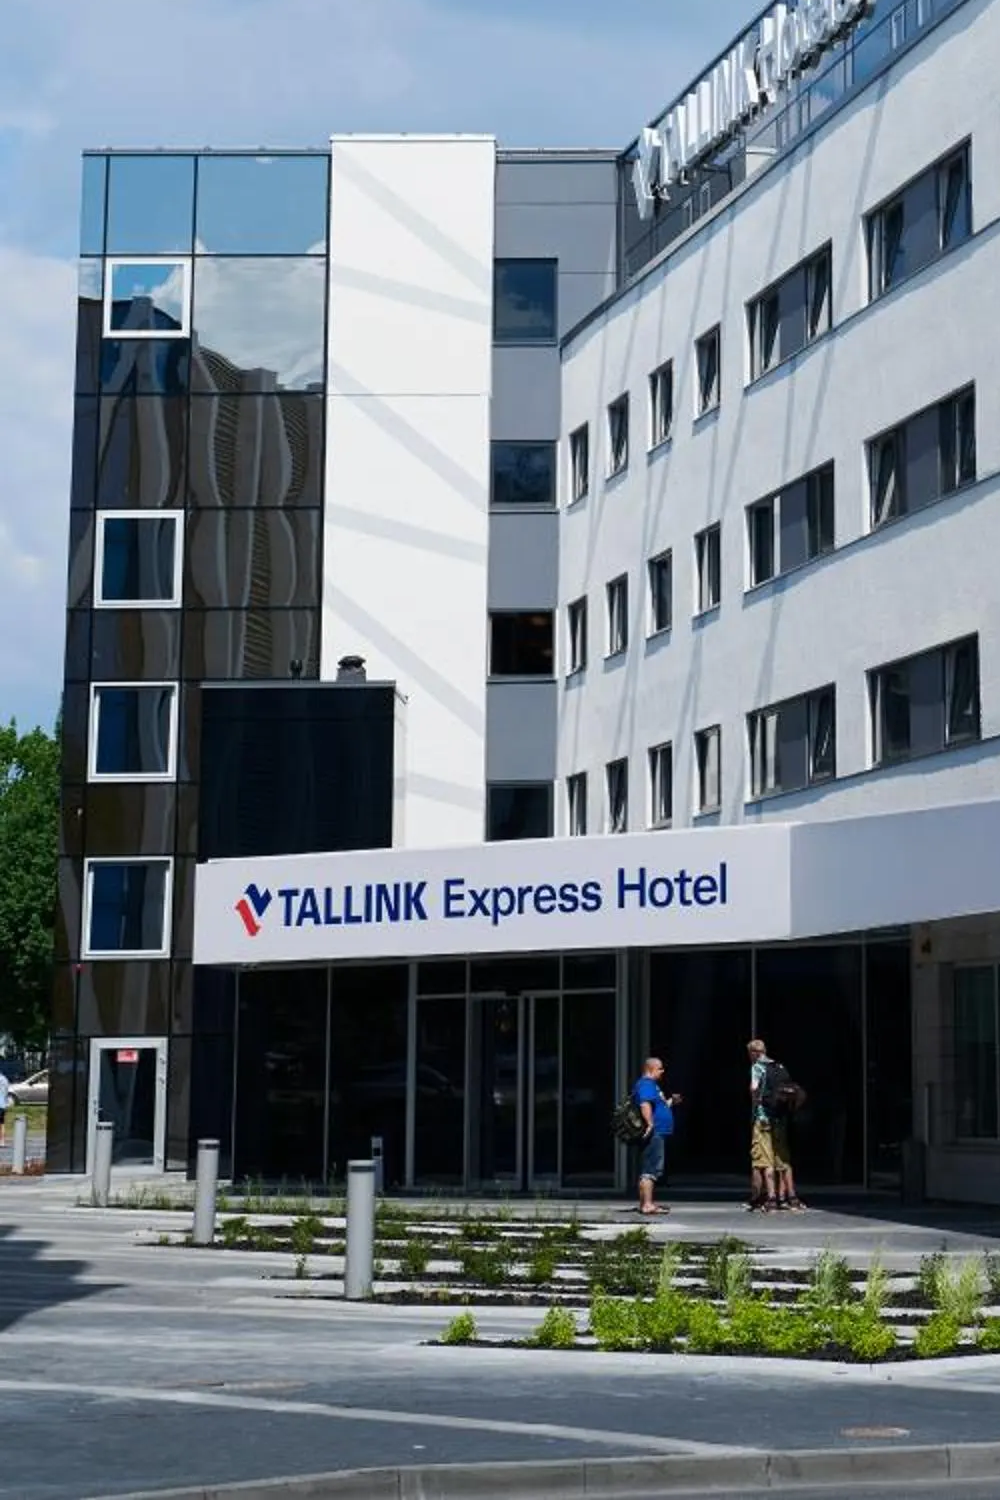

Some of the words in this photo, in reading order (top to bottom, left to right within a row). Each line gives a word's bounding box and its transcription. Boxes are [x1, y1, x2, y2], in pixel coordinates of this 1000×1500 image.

[278, 880, 428, 926] TALLINK
[443, 878, 602, 926] Express
[617, 861, 728, 909] Hotel
